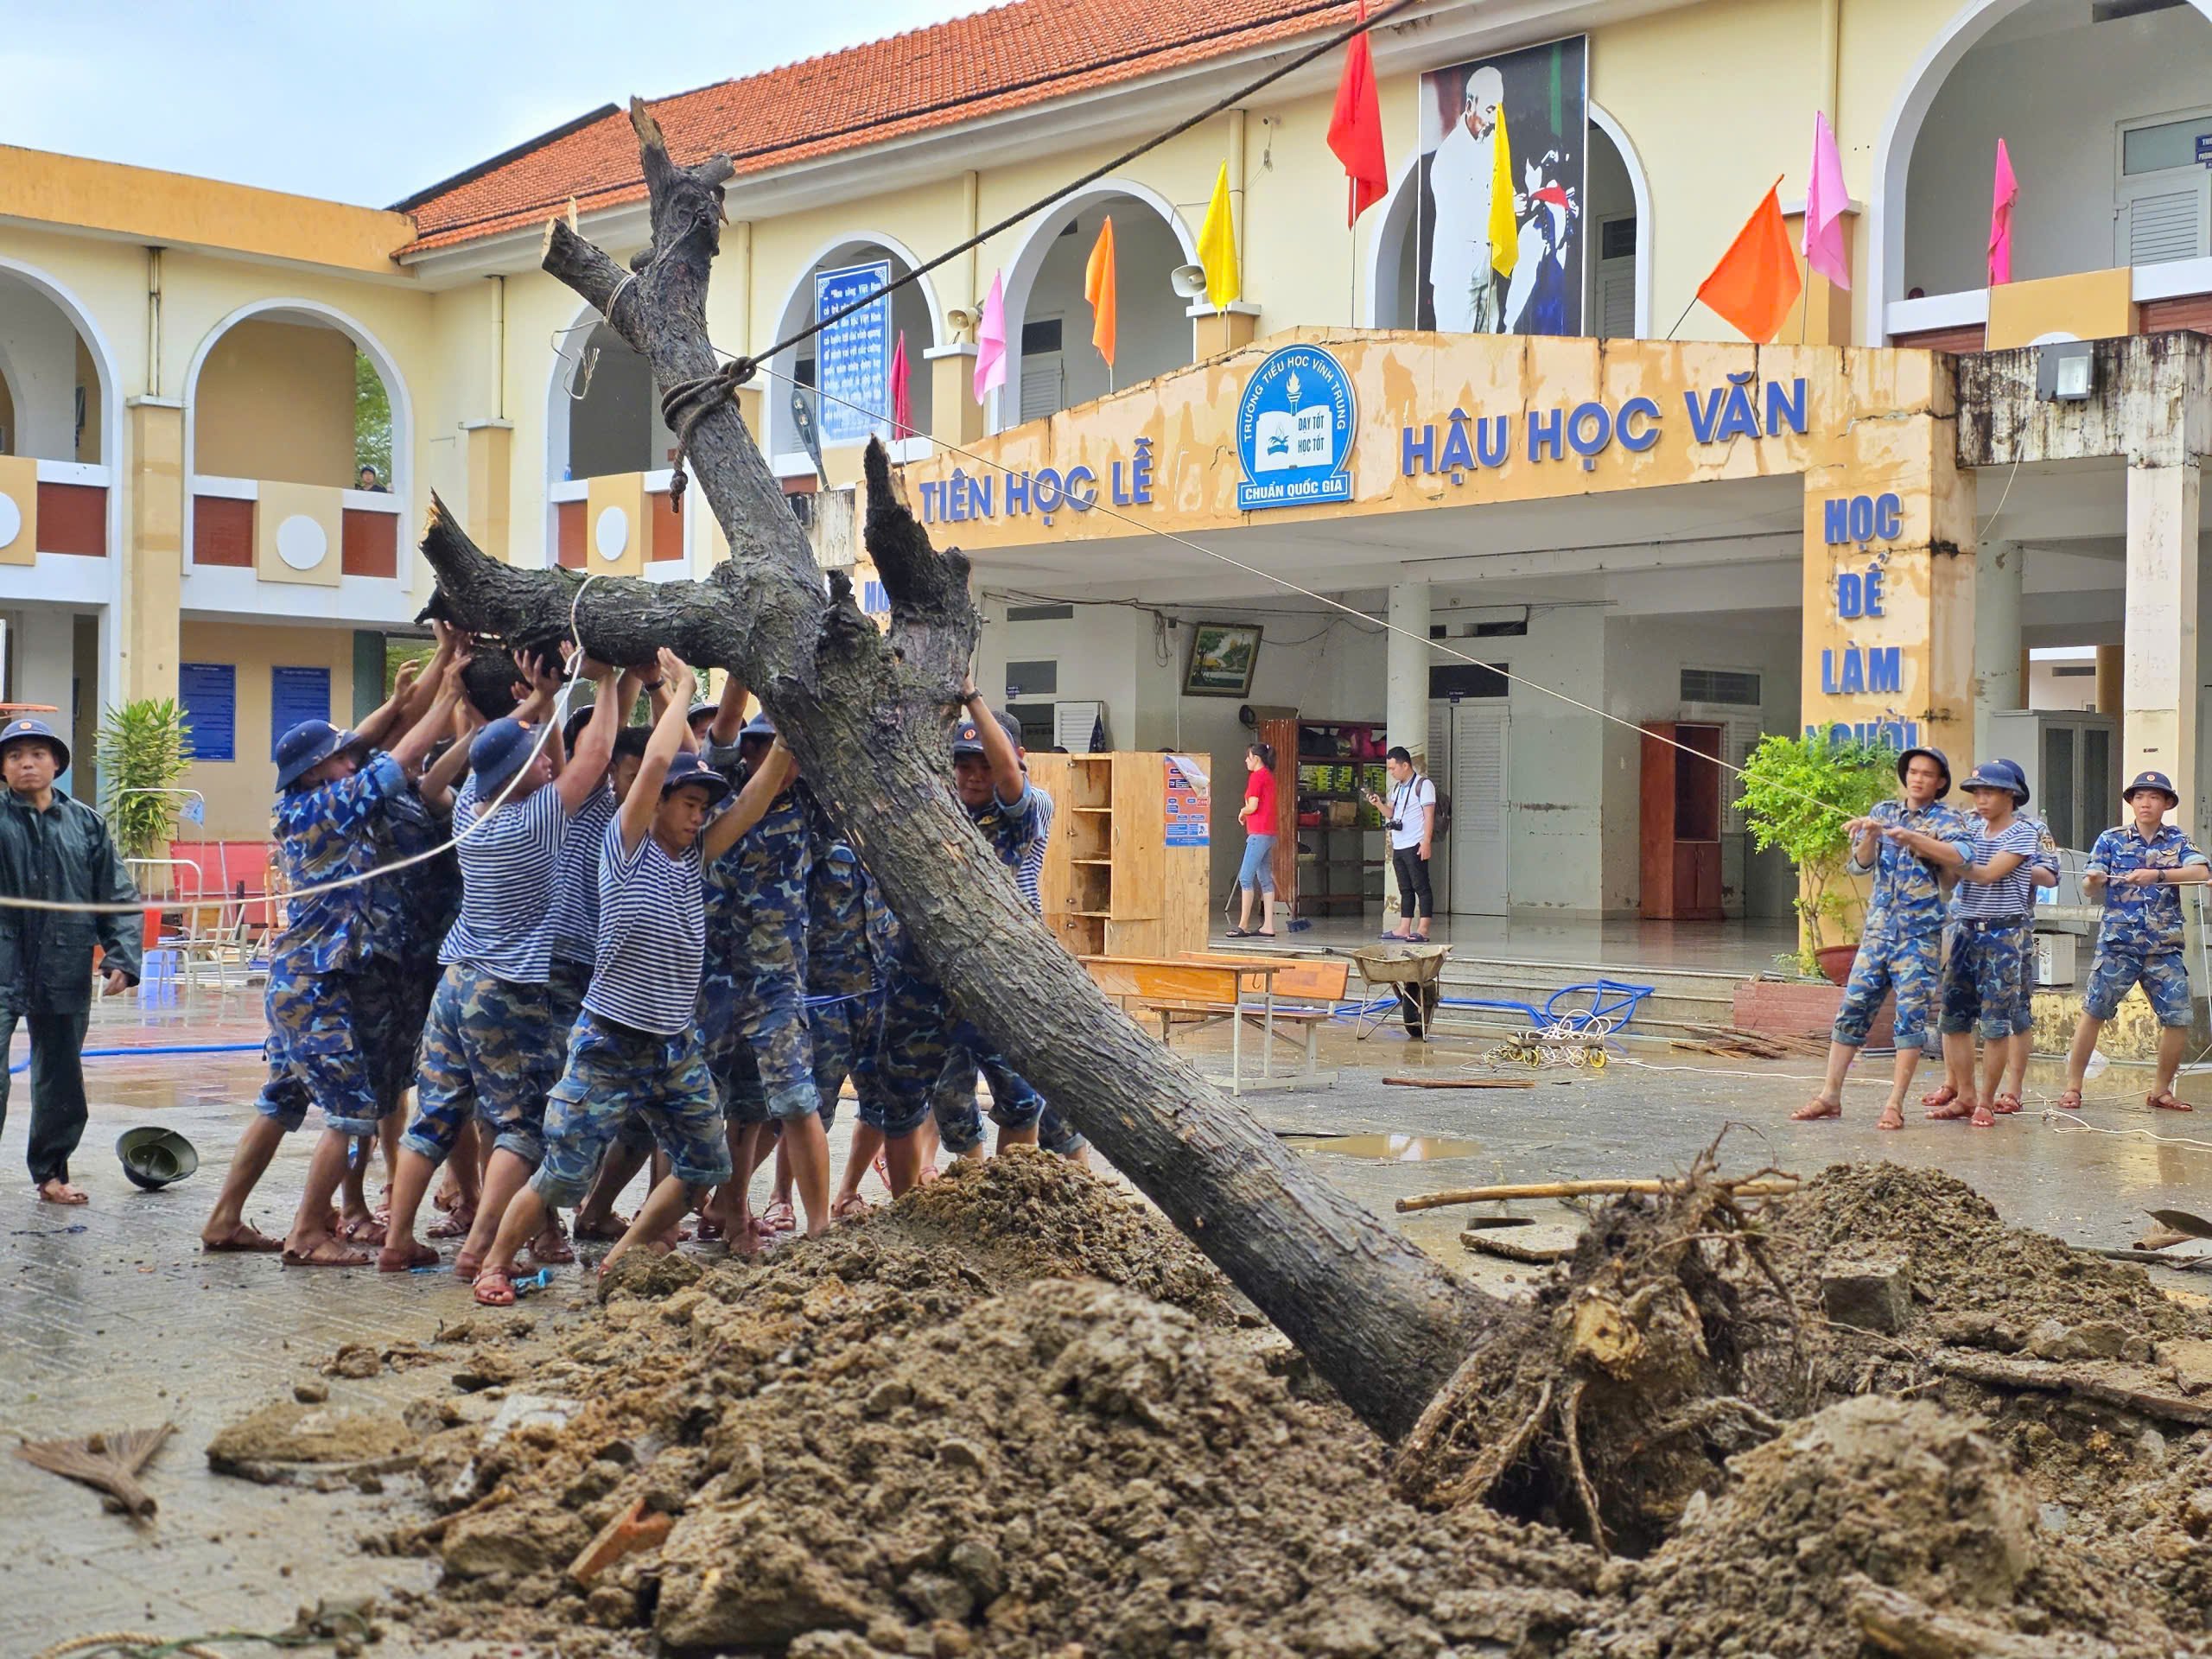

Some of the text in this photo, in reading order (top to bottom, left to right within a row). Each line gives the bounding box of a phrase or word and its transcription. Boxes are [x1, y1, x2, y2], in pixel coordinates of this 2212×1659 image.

[1244, 355, 1347, 442] TRƯỜNG TIỂU HỌC VĨNH TRUNG
[1313, 410, 1325, 429] TỐT
[1402, 371, 1809, 486] HẬU HỌC VĂN
[1298, 432, 1325, 456] HỌC TỐT
[919, 436, 1154, 527] TIÊN HỌC LỄ
[1245, 478, 1343, 501] CHUẨN QUỐC GIA
[1824, 493, 1904, 553] HỌC
[1837, 552, 1890, 619] ĐỂ
[1821, 639, 1904, 695] LÀM
